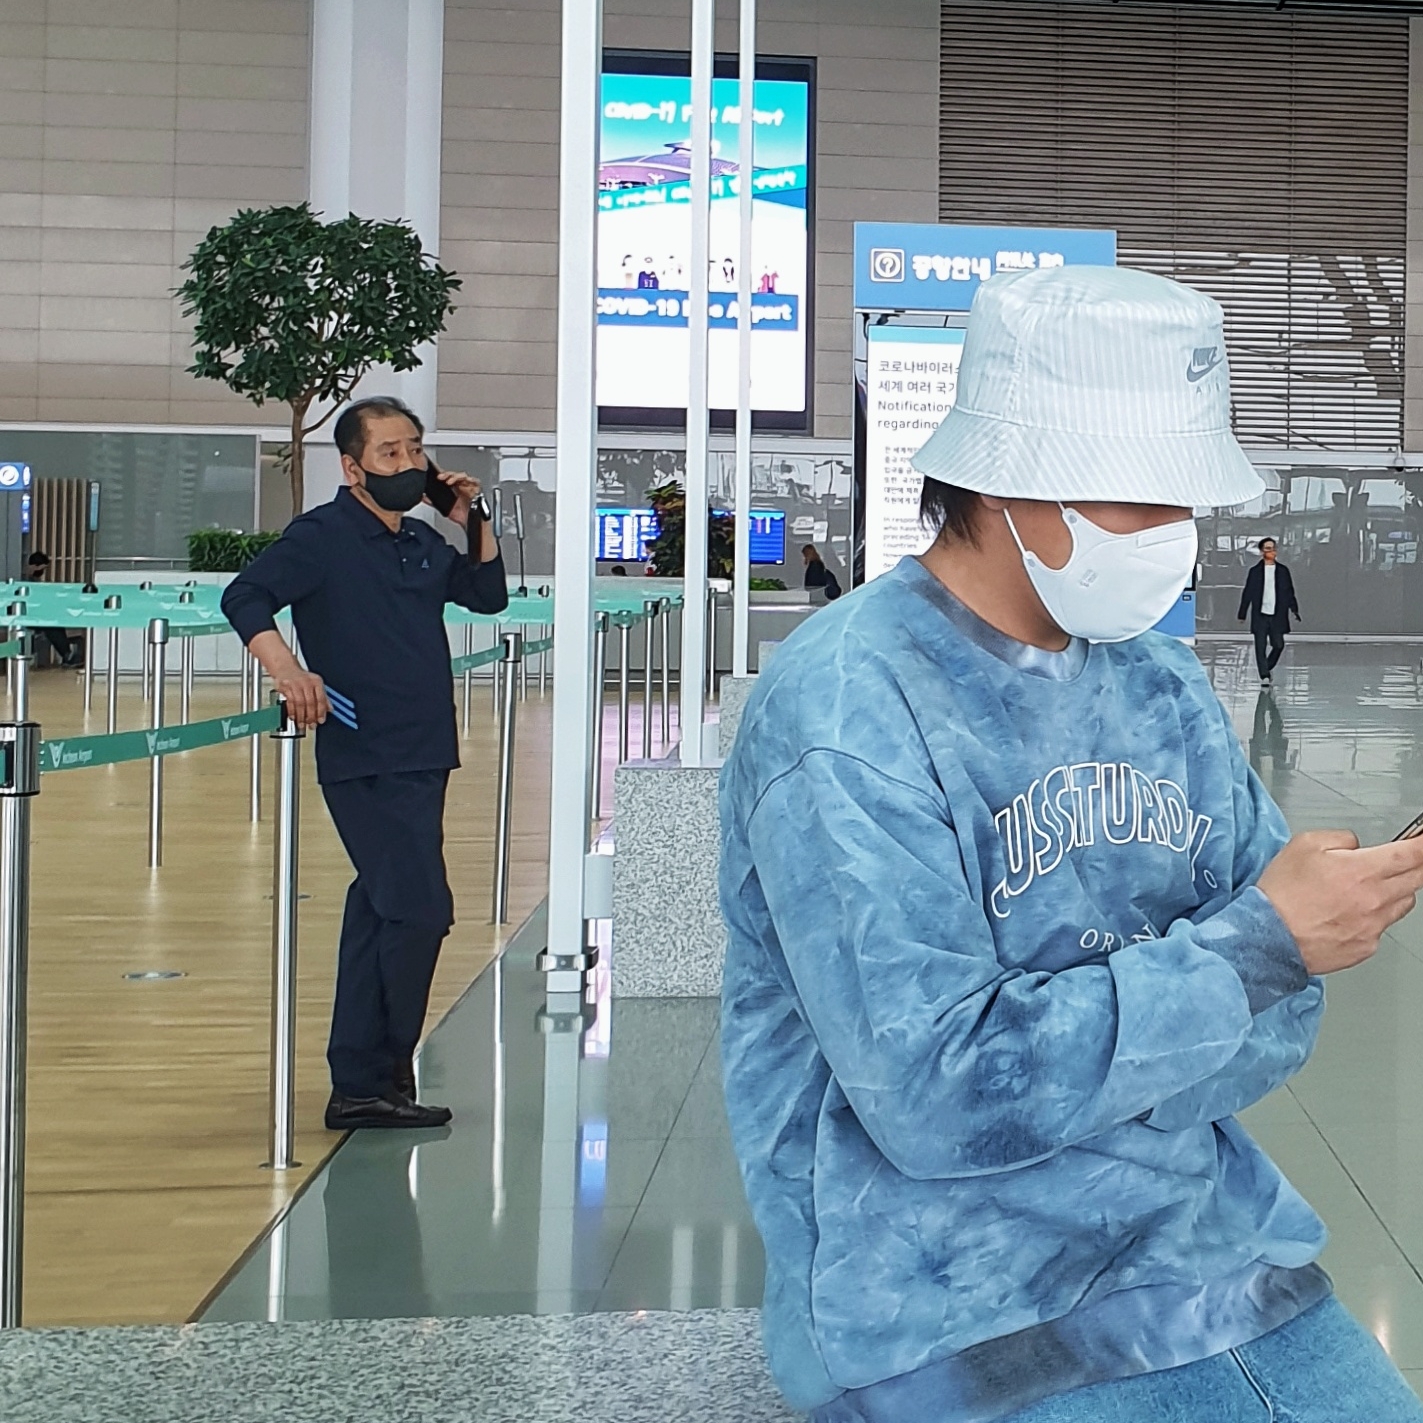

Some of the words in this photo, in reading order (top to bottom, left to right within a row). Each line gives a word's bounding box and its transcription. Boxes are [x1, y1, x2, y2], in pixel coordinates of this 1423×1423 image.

[681, 106, 718, 124] Fe
[682, 300, 724, 318] Fe
[726, 302, 793, 323] Aport
[878, 380, 903, 394] 세계
[907, 380, 931, 394] 여러
[877, 400, 952, 413] Notification
[877, 418, 939, 431] regarding
